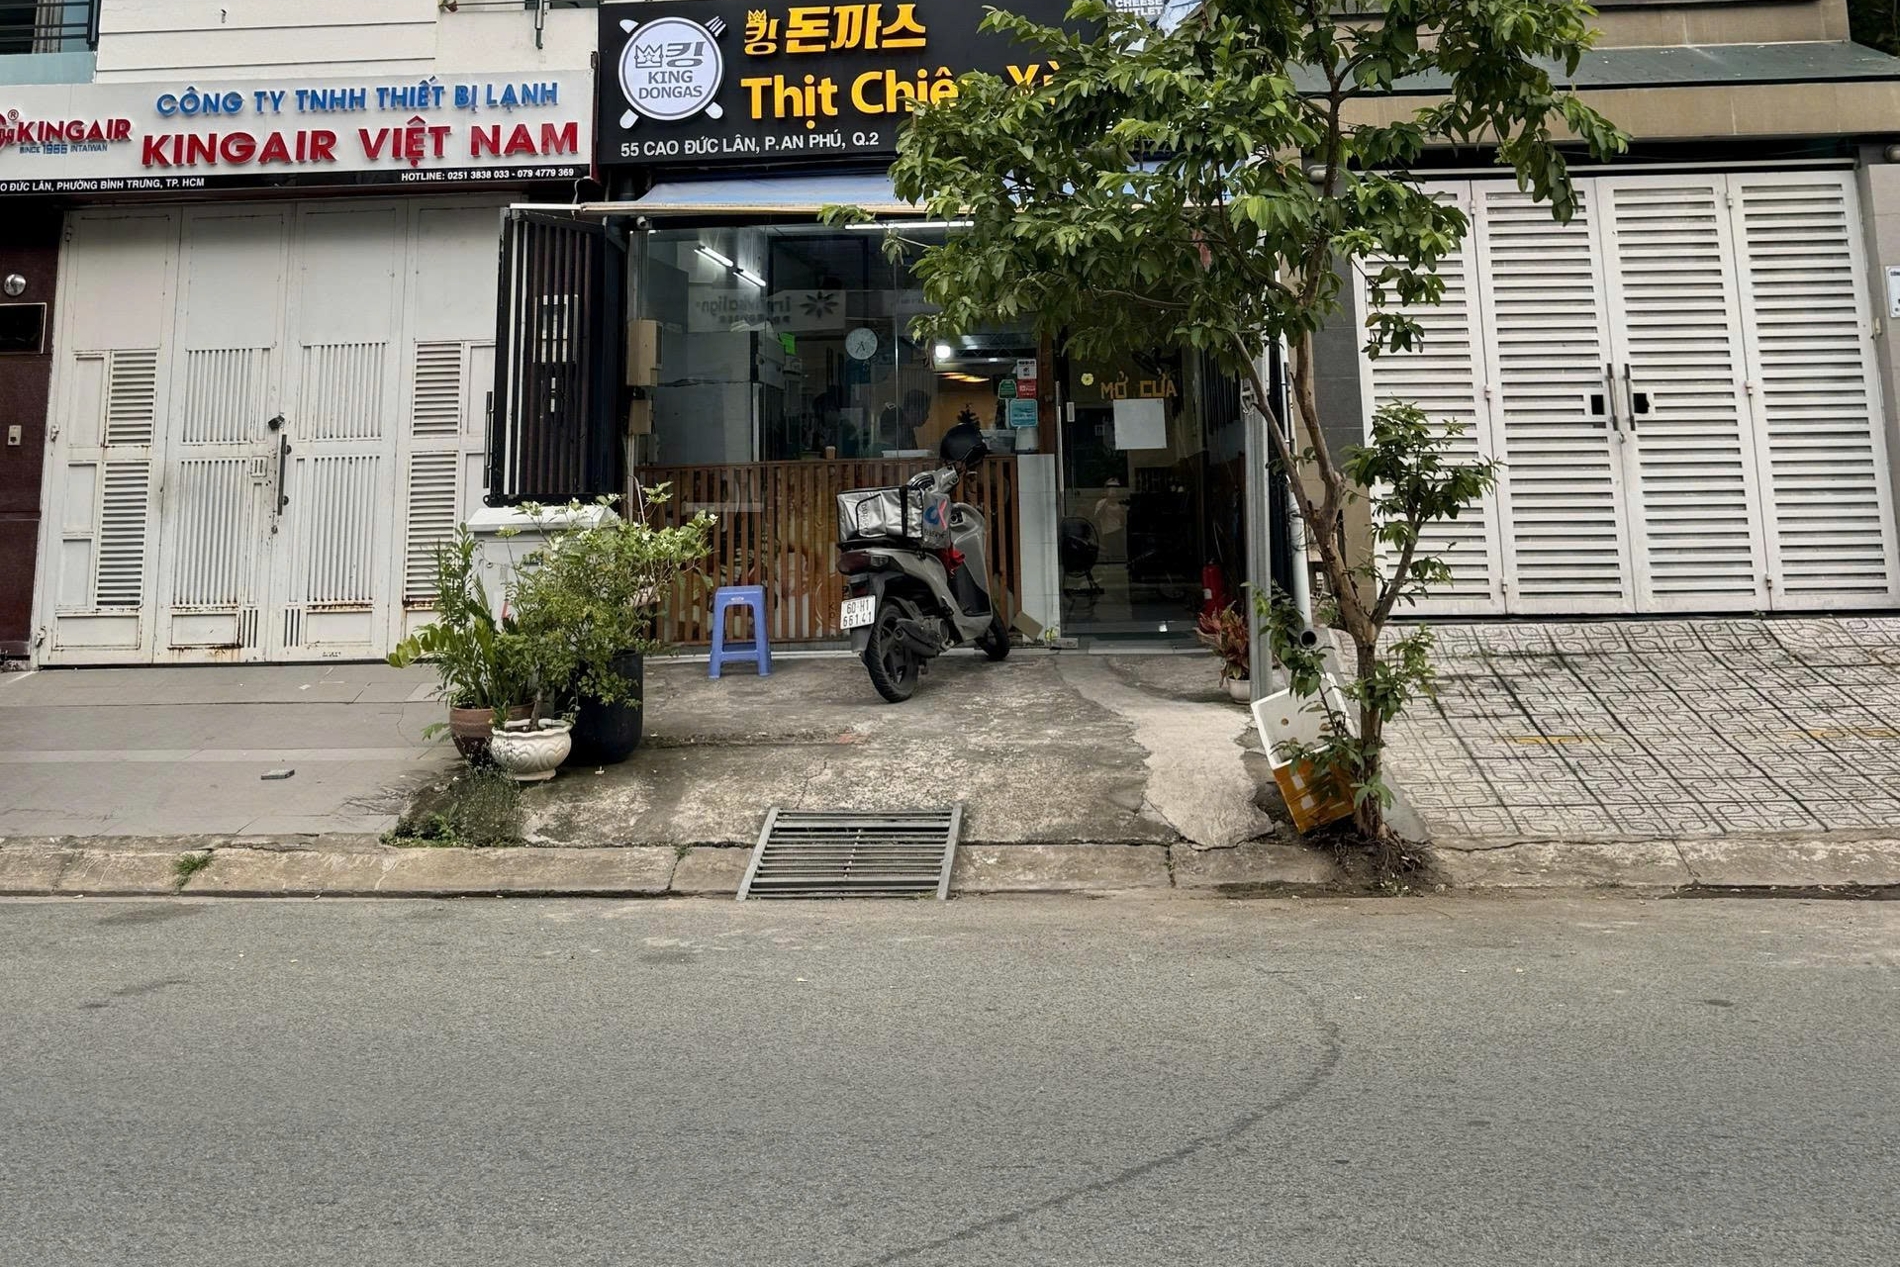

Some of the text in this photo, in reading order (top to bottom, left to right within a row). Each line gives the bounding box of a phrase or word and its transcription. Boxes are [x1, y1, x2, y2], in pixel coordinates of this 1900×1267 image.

[648, 70, 693, 84] KING
[156, 75, 558, 116] CÔNG TY TNHH THIẾT BỊ LẠNH
[639, 85, 703, 99] DONGAS
[741, 73, 838, 129] Thịt
[851, 66, 968, 114] Chiê
[17, 118, 132, 142] KINGAIR
[141, 115, 579, 167] KINGAIR VIỆT NAM
[620, 142, 639, 157] 55
[643, 140, 679, 156] CAO
[684, 135, 719, 155] ĐỨC
[723, 134, 760, 154] LÂN,
[809, 129, 846, 150] PHÚ,
[852, 131, 879, 146] Q.2
[9, 180, 30, 192] ĐỨC
[32, 180, 54, 192] LÂN,
[100, 178, 124, 190] BÌNH
[166, 178, 179, 187] TP.
[182, 177, 205, 187] HCM
[401, 172, 445, 181] HOTLINE:
[447, 171, 467, 180] 0251
[470, 170, 491, 179] 3838
[494, 170, 509, 179] 033
[517, 169, 533, 178] 079
[535, 168, 556, 177] 4779
[558, 168, 574, 177] 369
